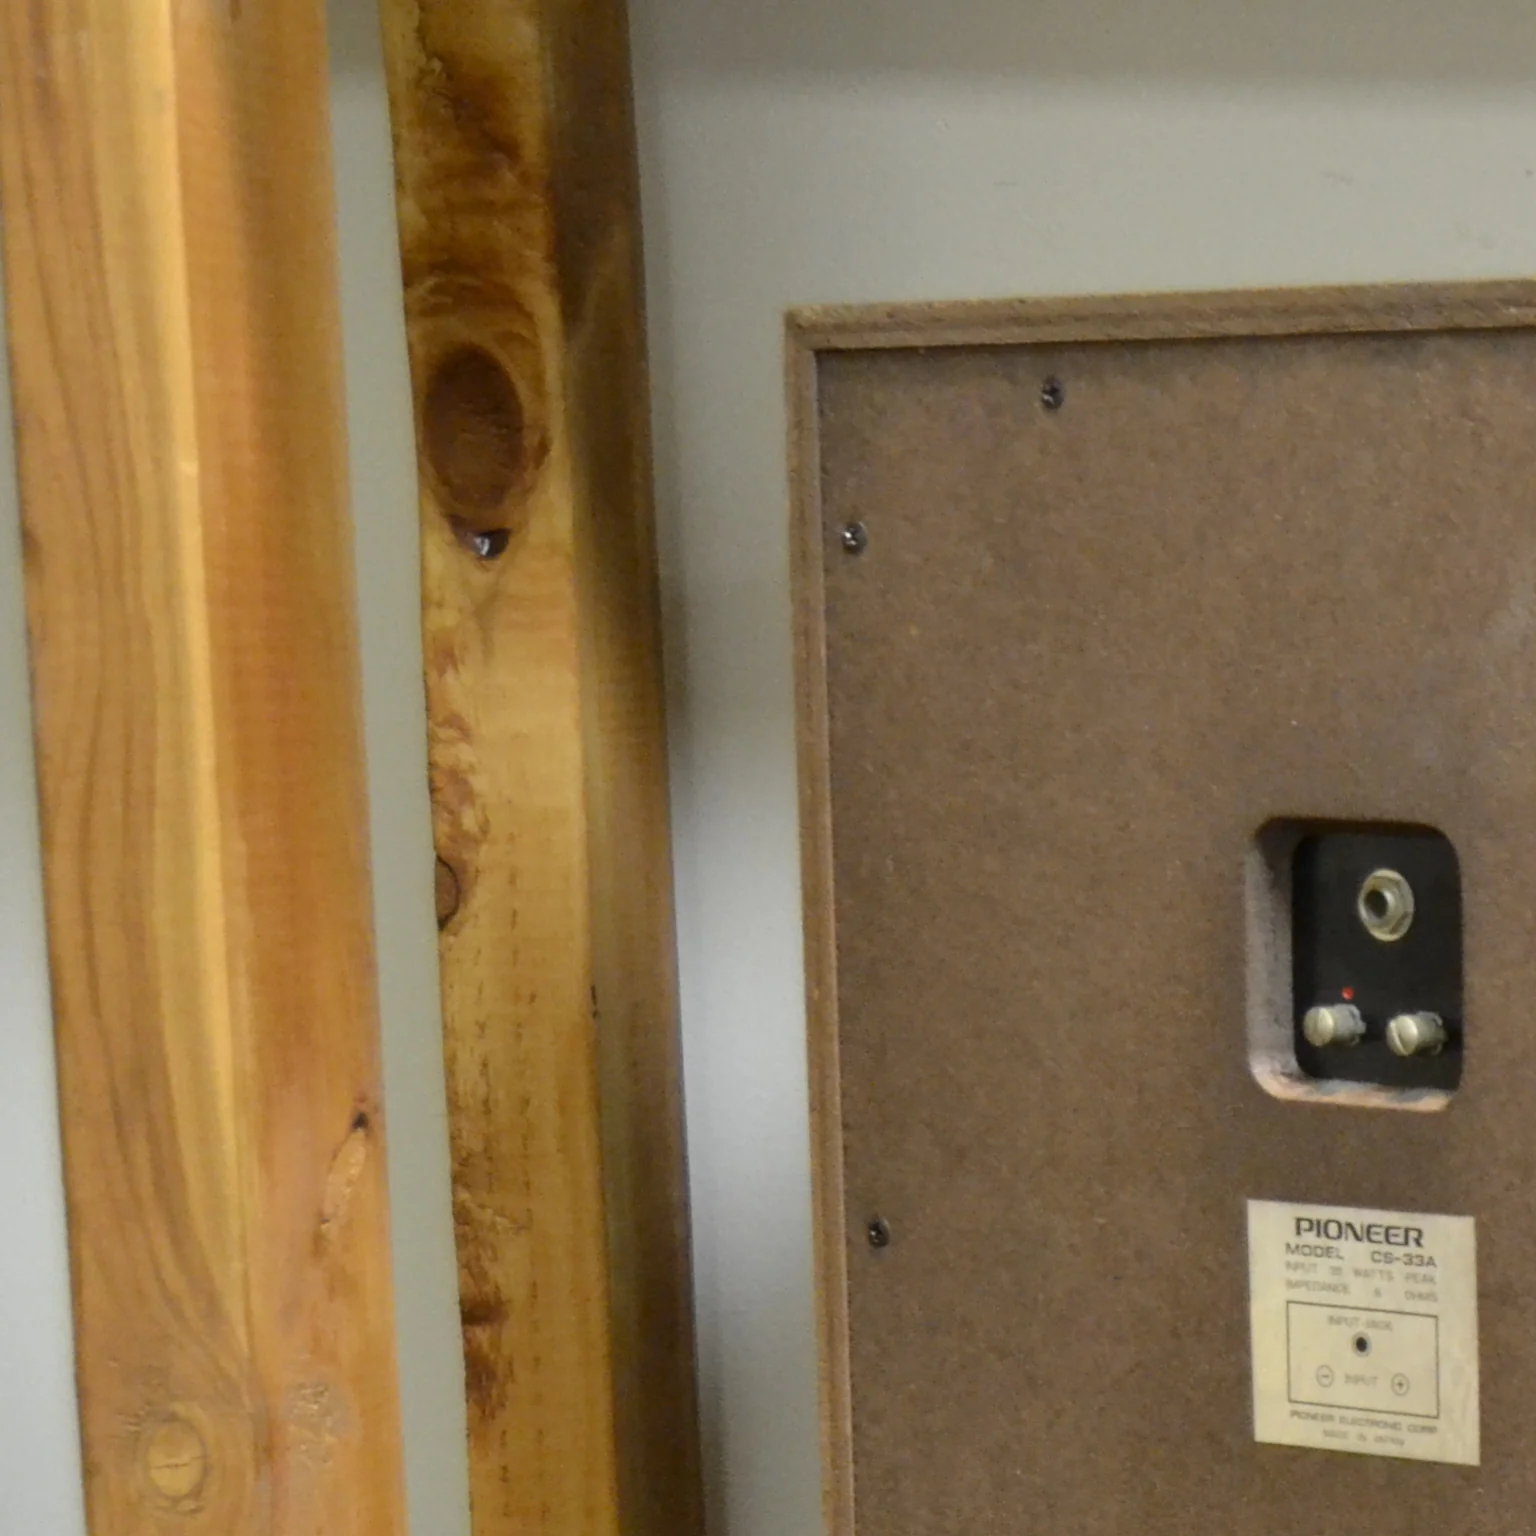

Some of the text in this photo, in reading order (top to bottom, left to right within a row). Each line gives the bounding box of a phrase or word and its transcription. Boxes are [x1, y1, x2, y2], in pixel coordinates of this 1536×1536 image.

[1294, 1217, 1424, 1248] PIONEER
[1285, 1242, 1438, 1269] MODEL CS-33A
